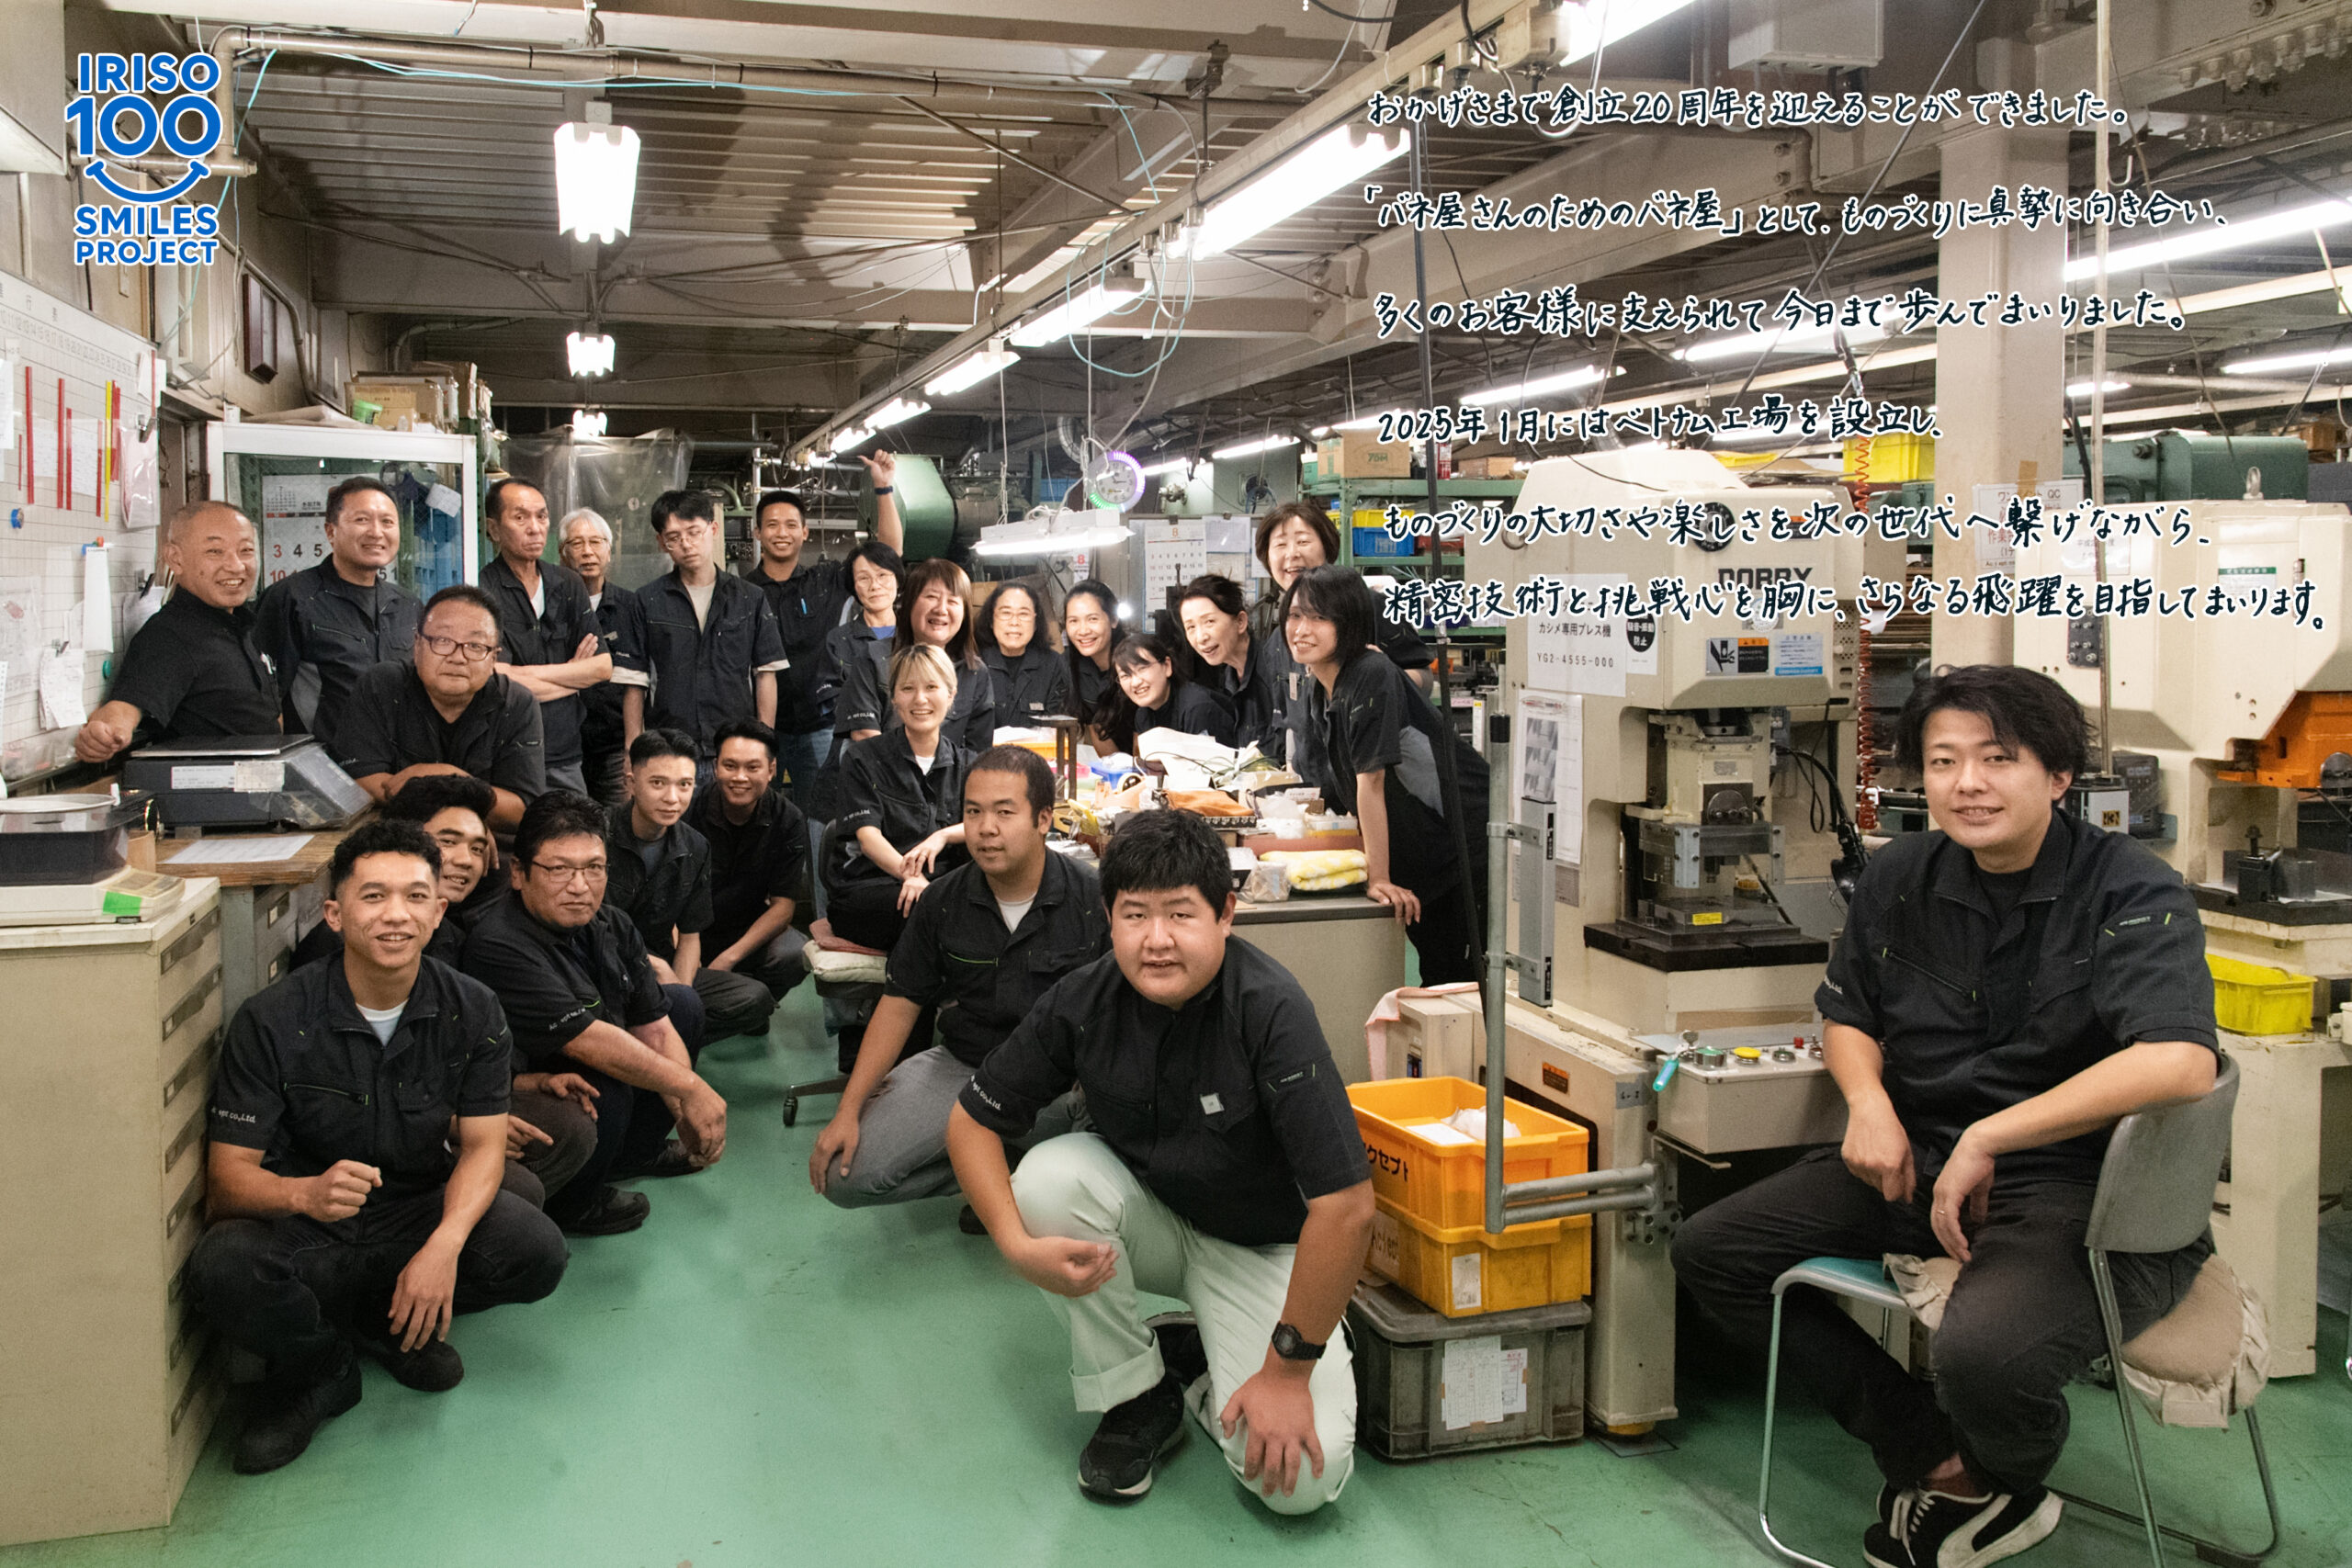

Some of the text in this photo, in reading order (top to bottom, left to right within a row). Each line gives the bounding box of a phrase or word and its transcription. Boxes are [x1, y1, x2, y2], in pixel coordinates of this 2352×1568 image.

[2047, 489, 2061, 499] QC
[273, 544, 322, 558] 3 4 5
[1078, 554, 1085, 565] 8
[269, 570, 286, 583] 10
[1539, 623, 1611, 637] カシメ専用プレス機
[1633, 635, 1647, 647] 防止
[1537, 652, 1614, 668] YG2-4555-000
